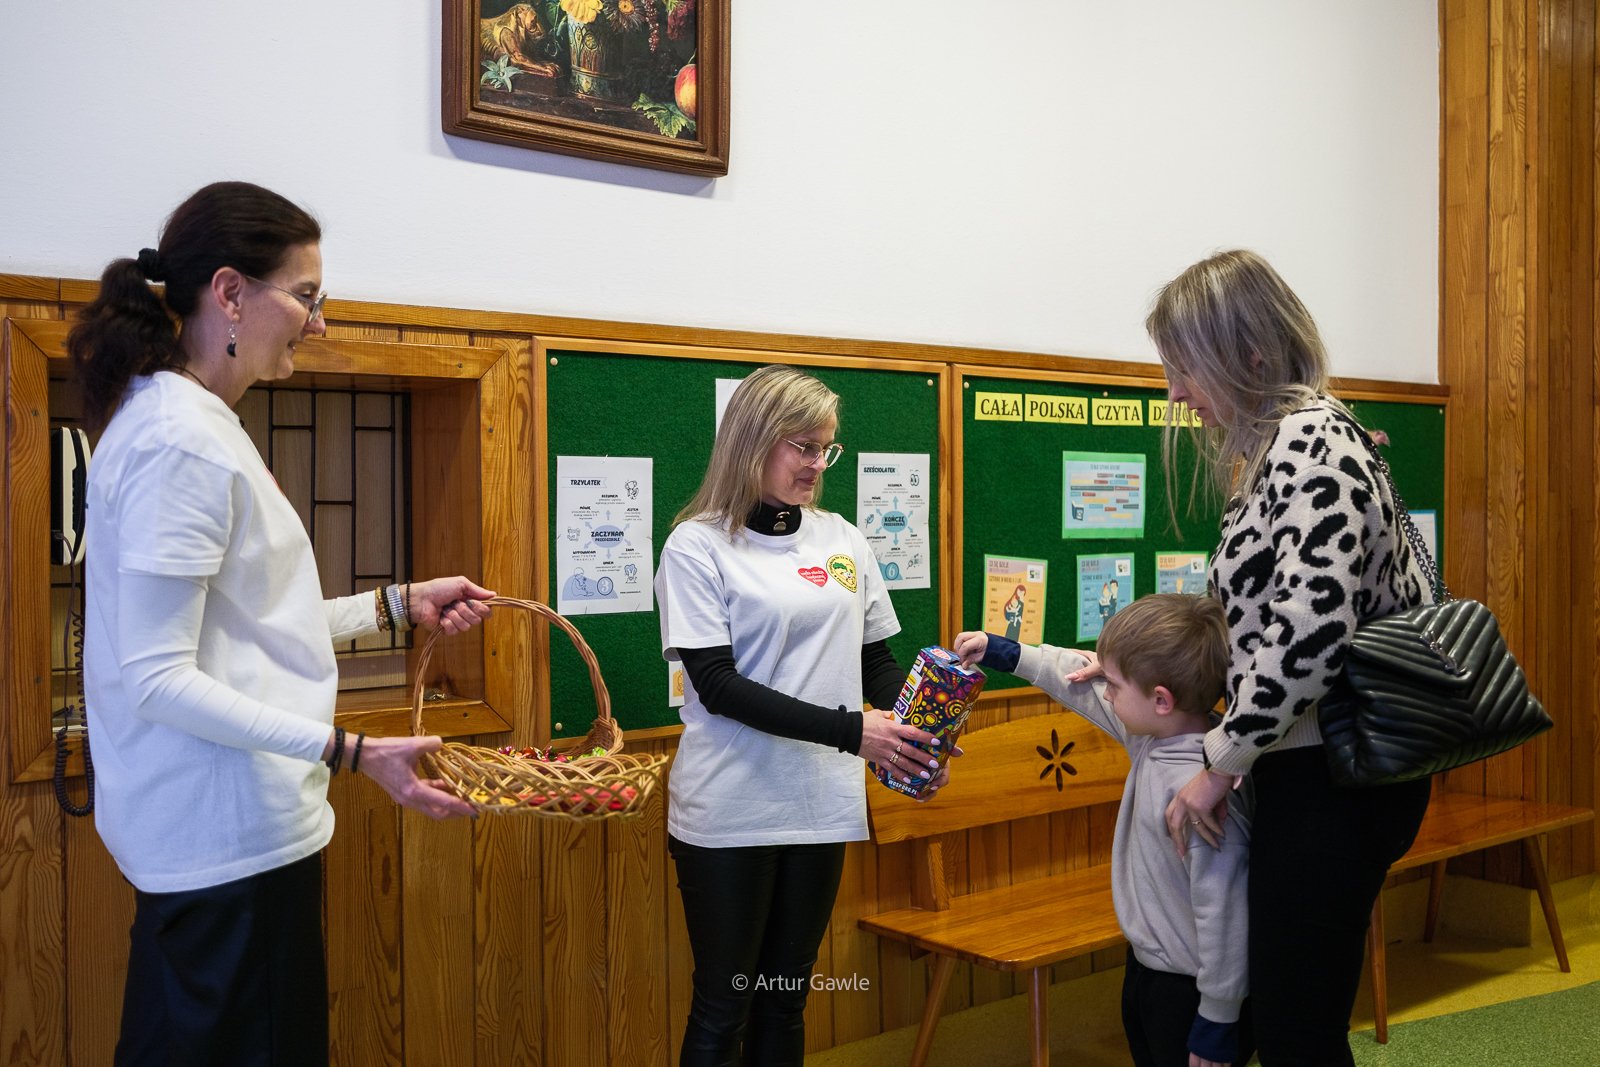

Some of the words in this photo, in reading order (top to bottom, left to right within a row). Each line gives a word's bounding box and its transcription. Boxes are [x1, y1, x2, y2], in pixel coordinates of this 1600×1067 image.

[980, 398, 1021, 417] CAŁA
[1029, 400, 1085, 419] POLSKA
[1096, 404, 1140, 421] CZYTA
